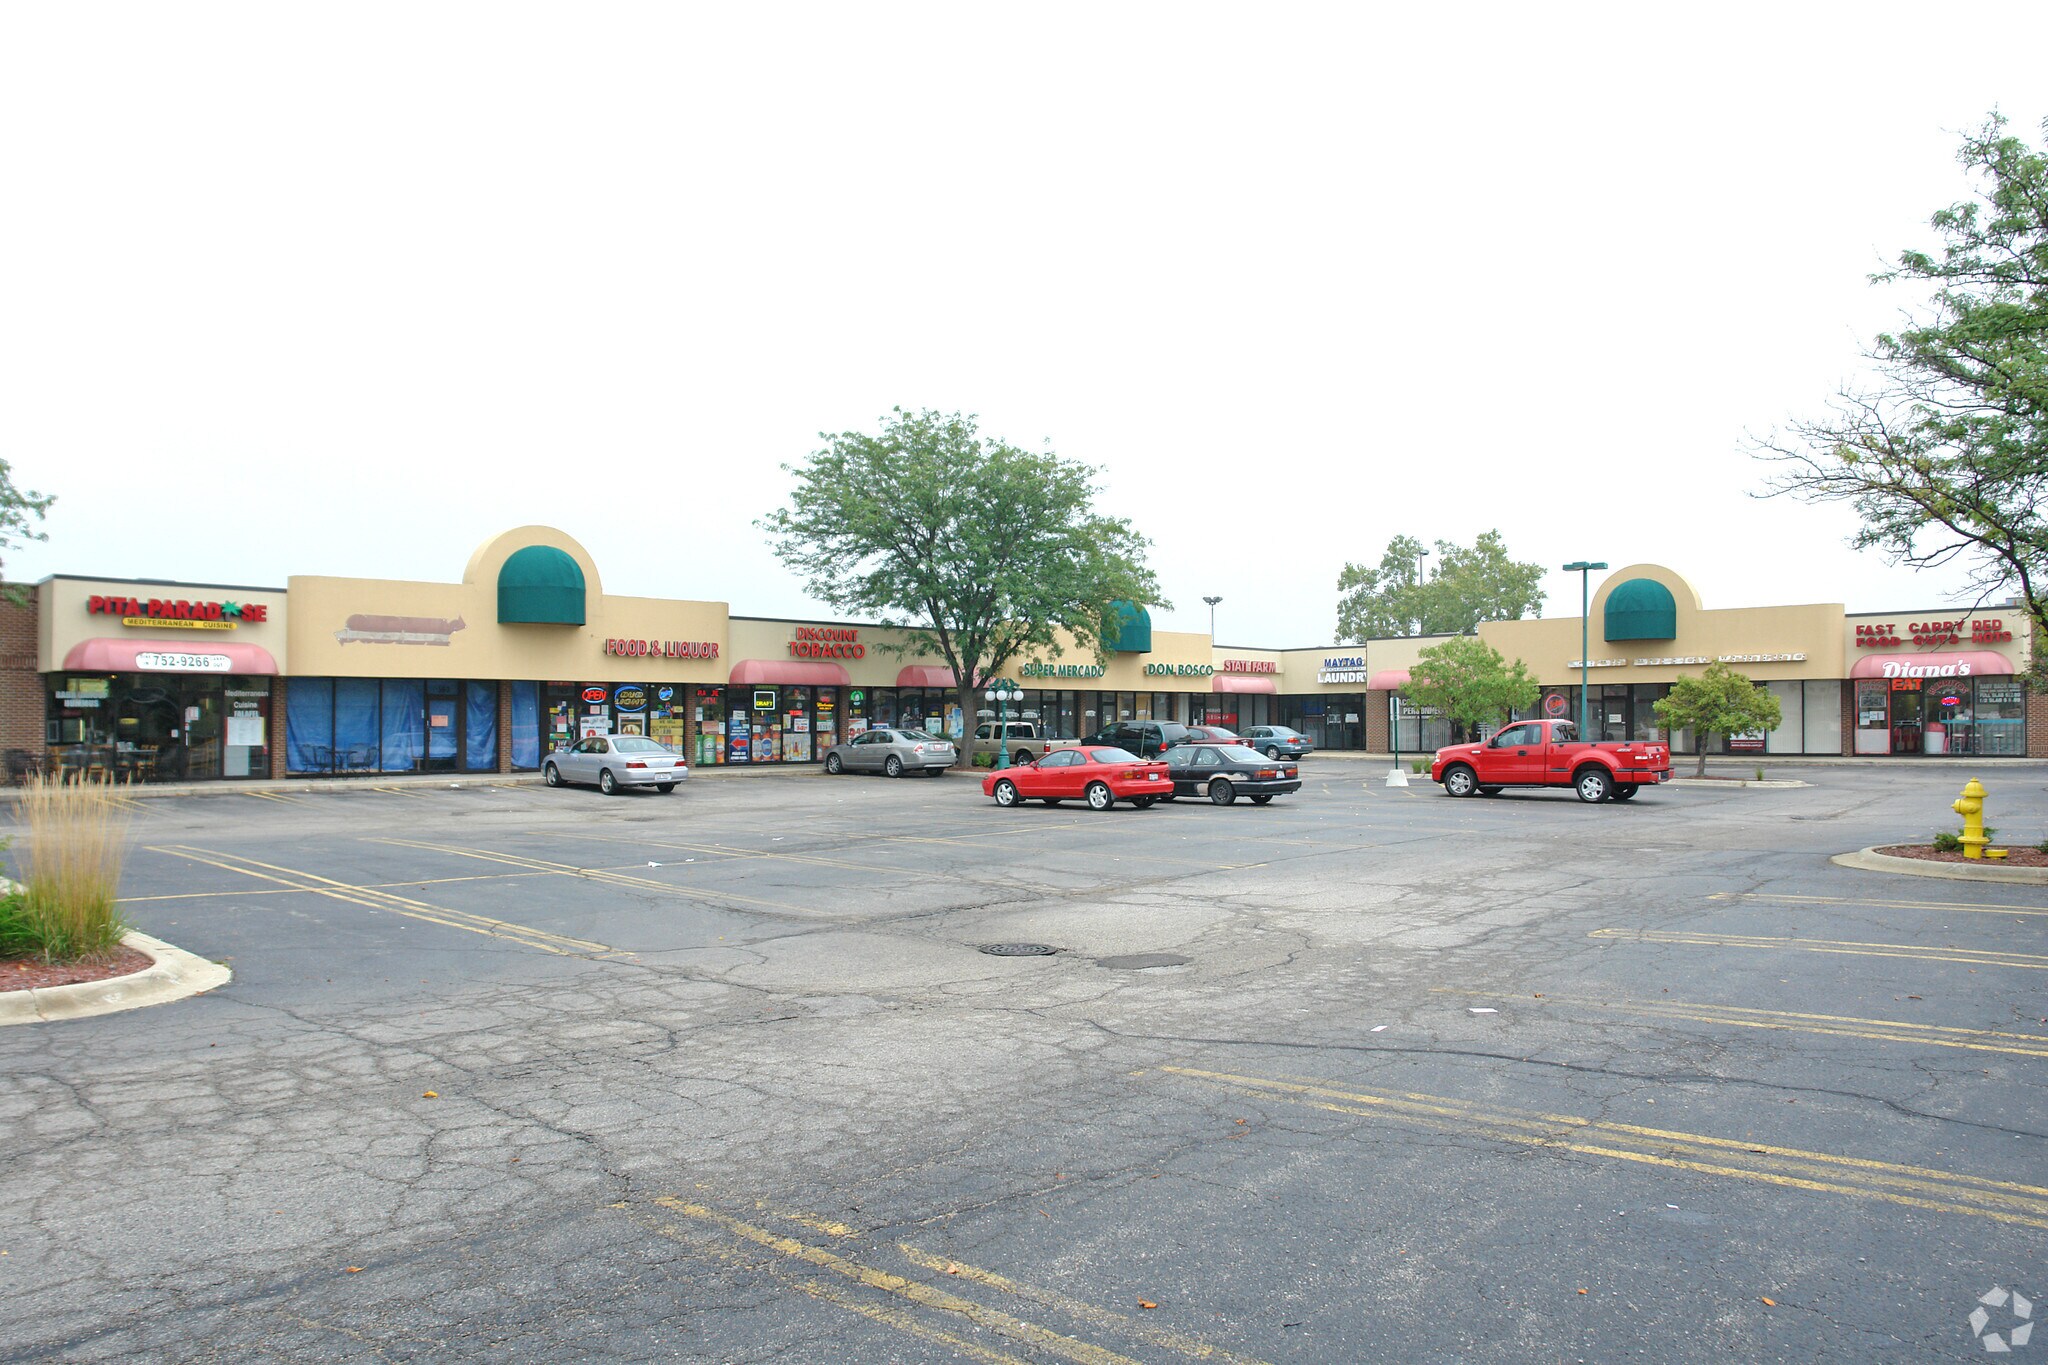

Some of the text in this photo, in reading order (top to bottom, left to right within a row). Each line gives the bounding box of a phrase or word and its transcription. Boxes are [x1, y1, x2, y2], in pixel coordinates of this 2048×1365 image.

[89, 596, 141, 616] PITA
[127, 618, 194, 627] MEDITERRANEAN
[1855, 619, 2002, 635] FAST CARRY RED
[796, 627, 858, 642] DISCOUNT
[1855, 637, 1901, 647] FOOD
[1972, 631, 2012, 643] HOTS
[606, 639, 719, 659] FOOD & LIQUOR
[789, 642, 865, 659] TOBACCO
[153, 656, 209, 667] 752-9266
[1224, 660, 1276, 673] STATE FARM
[1325, 657, 1363, 667] MAYTAG
[1882, 659, 1970, 678] Diana's
[1023, 663, 1105, 678] SUPER MERCADO
[1147, 663, 1214, 676] DON BOSCO
[1892, 679, 1922, 691] EAT
[1927, 680, 1969, 695] BURRITOS
[582, 690, 607, 700] OPEN
